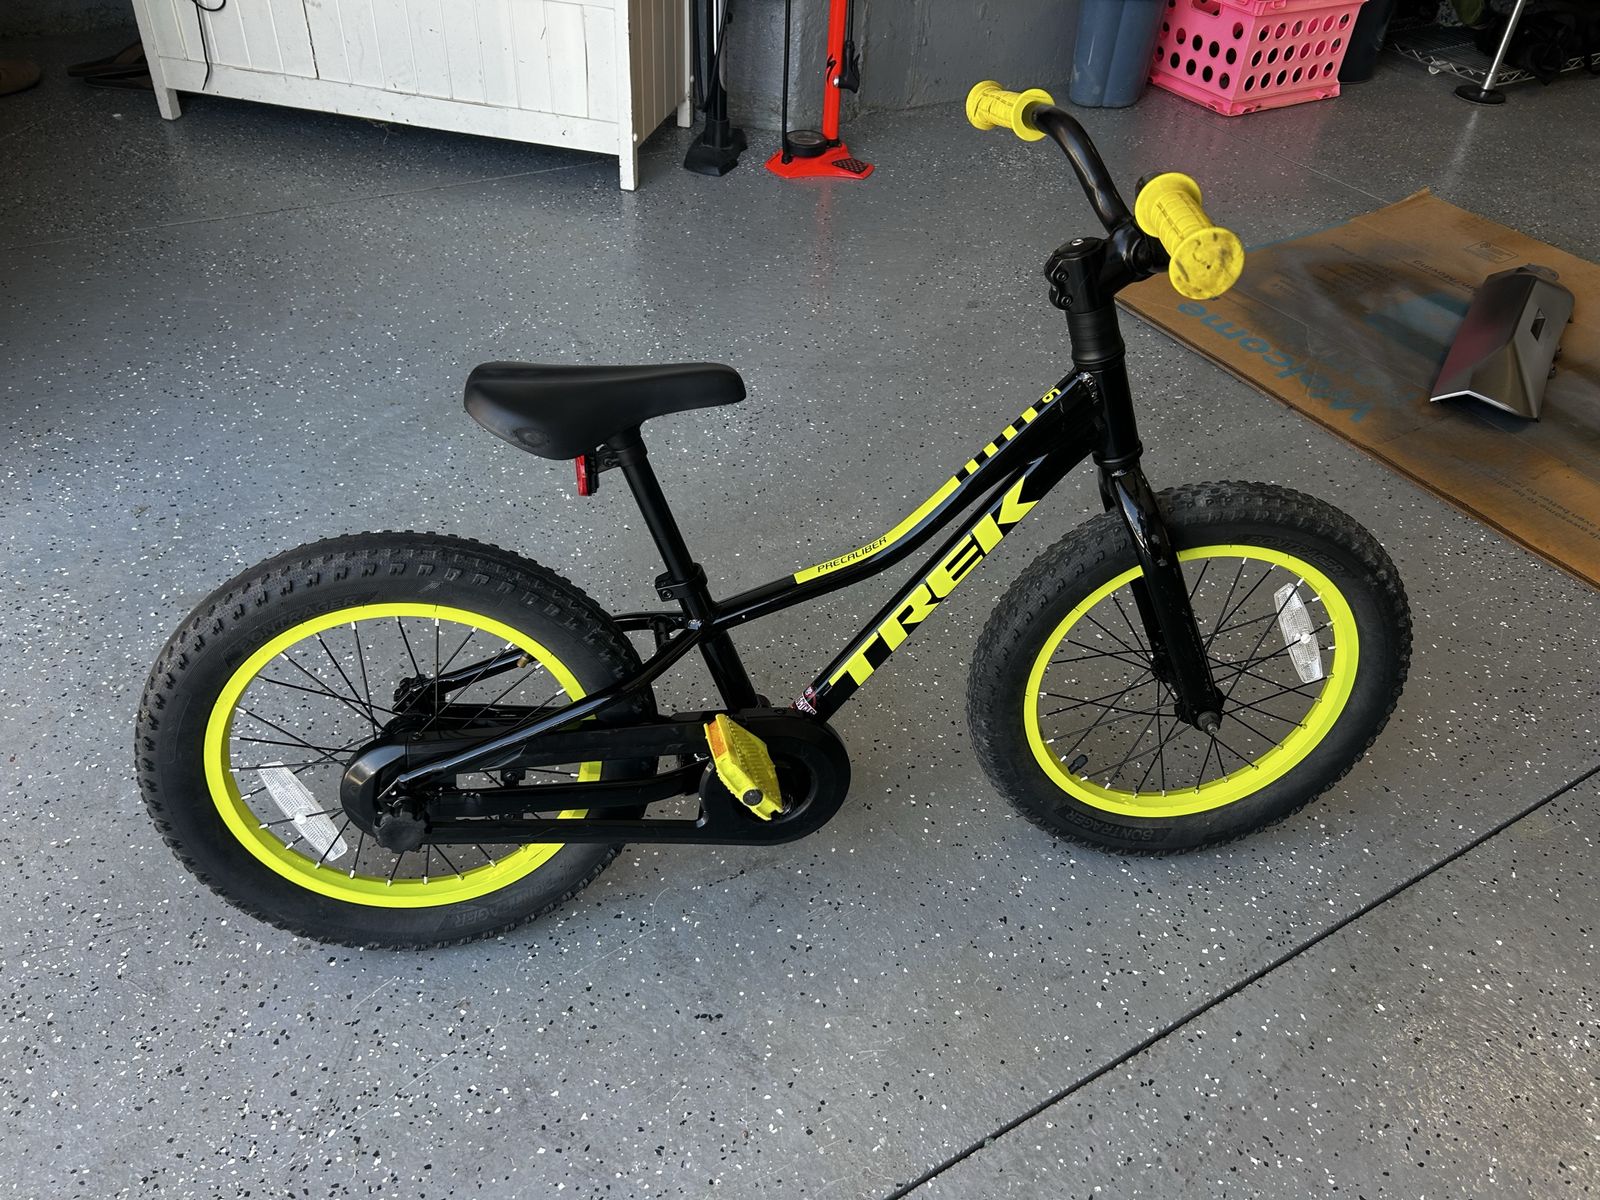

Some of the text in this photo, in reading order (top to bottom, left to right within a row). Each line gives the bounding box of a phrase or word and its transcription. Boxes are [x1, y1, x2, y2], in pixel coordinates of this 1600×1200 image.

[1041, 386, 1062, 404] 6
[1177, 302, 1374, 423] Welcome
[817, 536, 887, 573] PRECALIBER
[828, 475, 1040, 687] TREK
